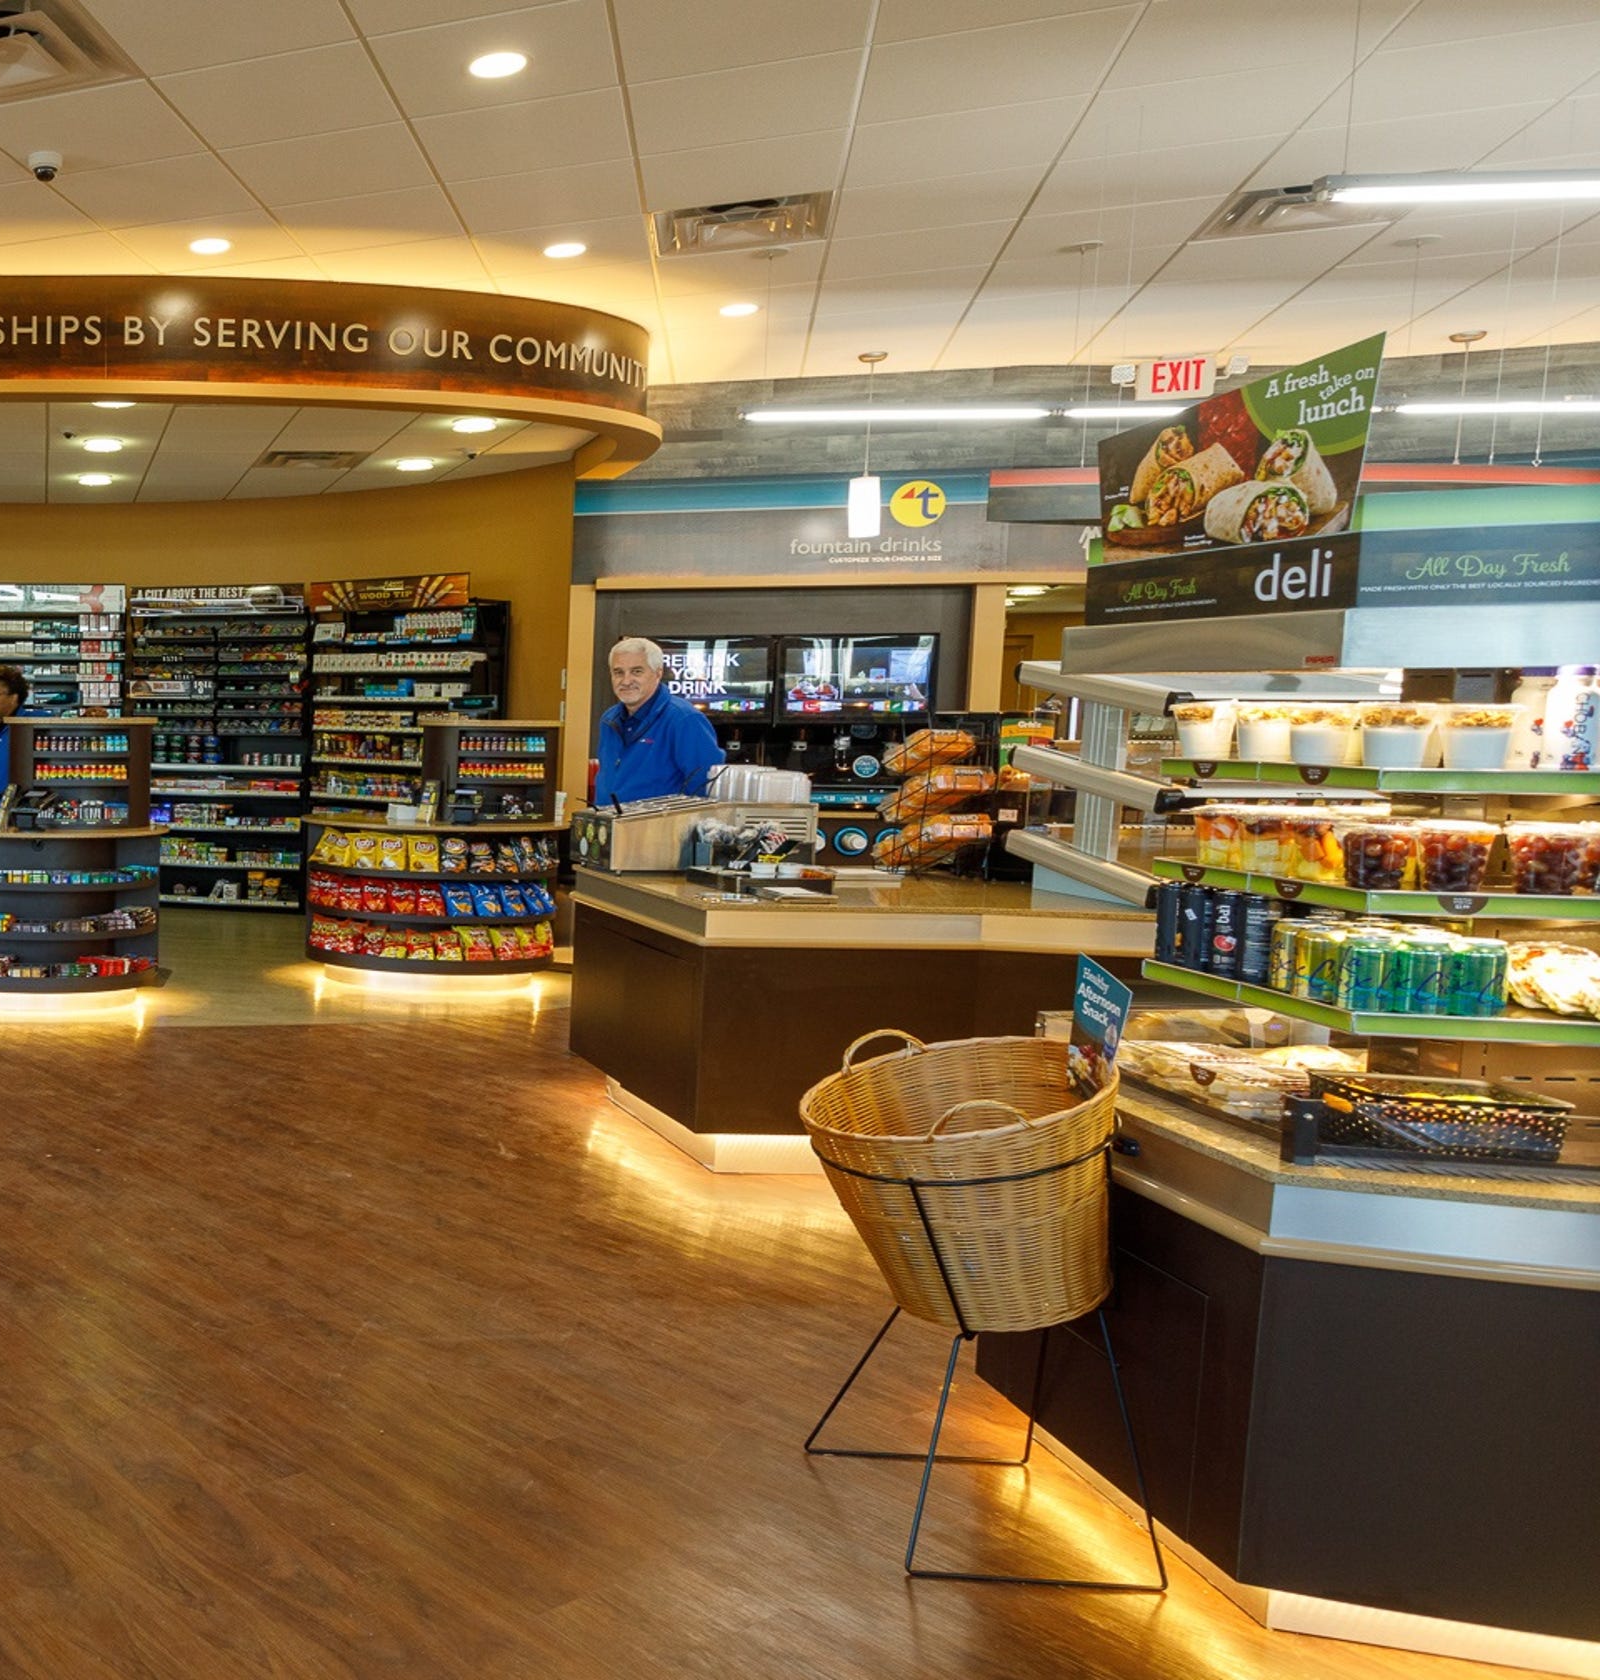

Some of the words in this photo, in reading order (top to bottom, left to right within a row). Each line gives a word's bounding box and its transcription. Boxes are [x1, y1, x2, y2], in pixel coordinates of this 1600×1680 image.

[123, 315, 171, 346] BY
[193, 317, 369, 355] SERVING
[388, 325, 473, 361] OUR
[489, 334, 648, 392] COMMUNITY
[1151, 359, 1206, 394] EXIT
[1265, 379, 1280, 398] A
[1283, 364, 1330, 394] fresh
[1318, 374, 1352, 400] take
[1355, 367, 1375, 381] on
[1297, 386, 1366, 425] lunch
[790, 537, 871, 555] fountain
[879, 536, 942, 553] drinks
[1254, 548, 1333, 602] deli
[1406, 556, 1450, 580] All
[1455, 554, 1507, 579] Day
[1512, 551, 1572, 576] Fresh
[166, 588, 196, 599] ABOVE
[198, 587, 217, 598] THE
[1123, 583, 1143, 603] All
[1144, 581, 1168, 601] Day
[1169, 577, 1197, 598] Fresh
[662, 653, 740, 667] REIK
[668, 681, 728, 694] DRINK
[1077, 982, 1121, 1017] Afternoon
[1082, 1001, 1109, 1027] Snack
